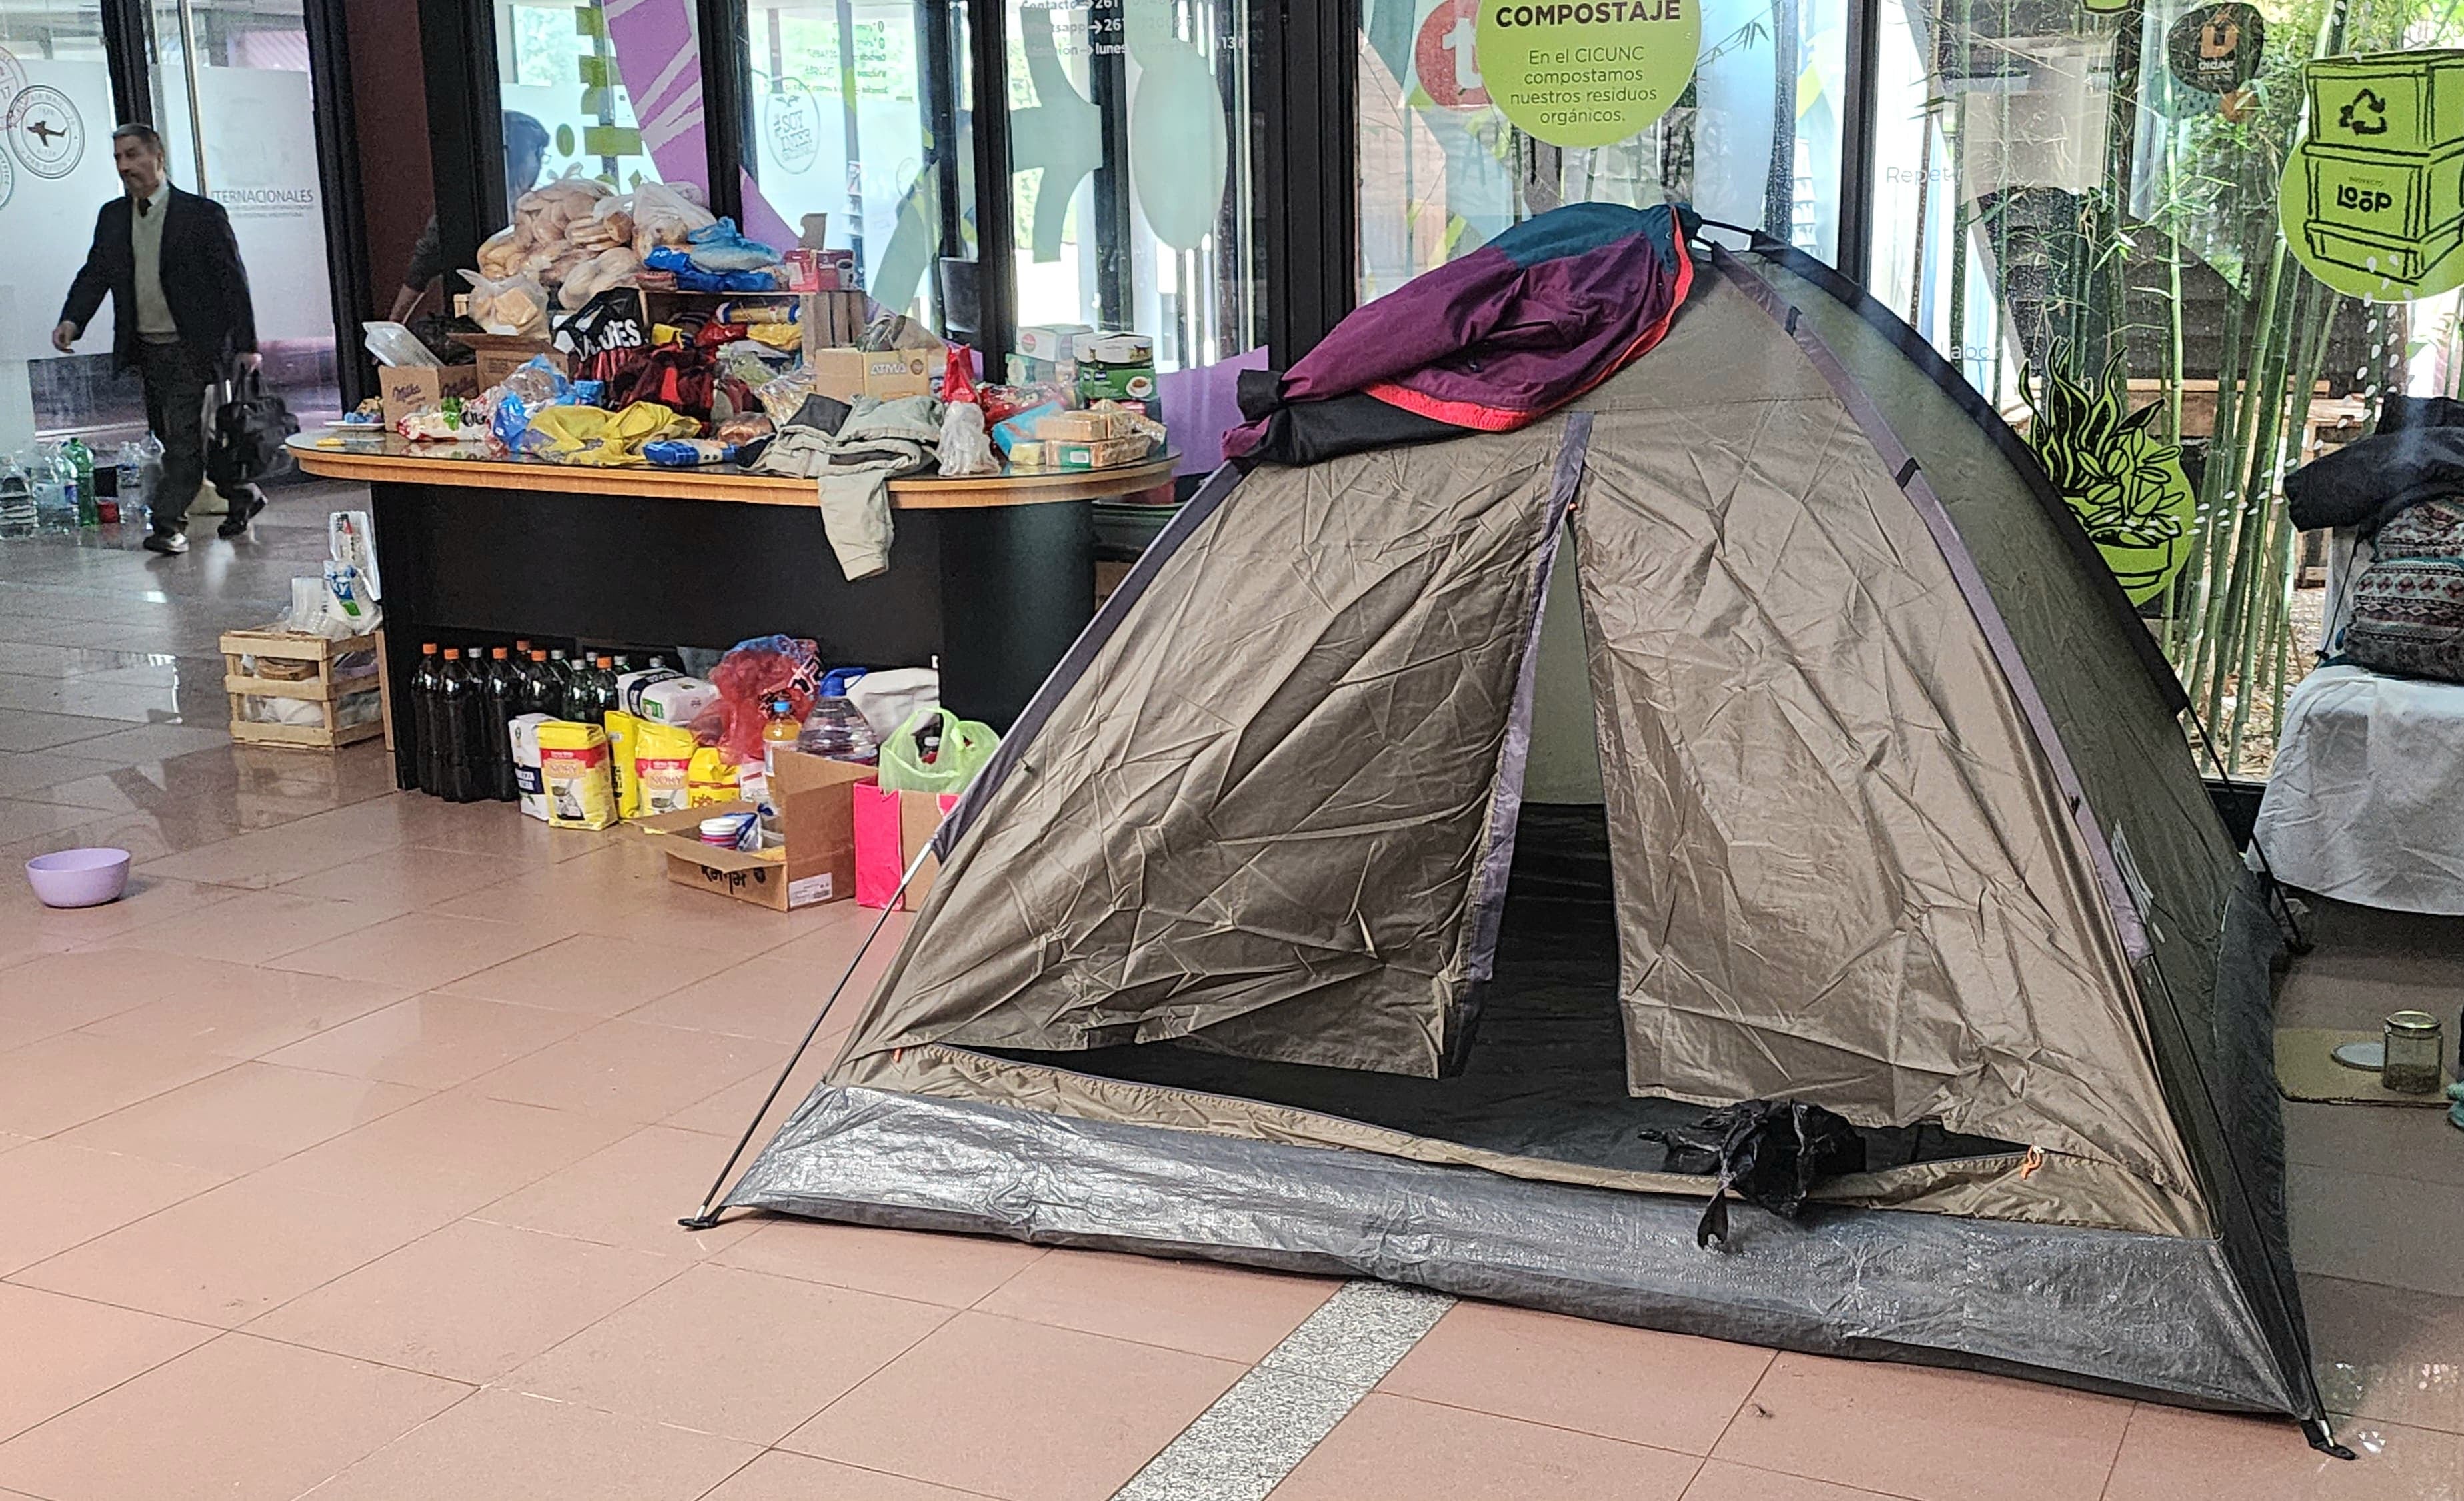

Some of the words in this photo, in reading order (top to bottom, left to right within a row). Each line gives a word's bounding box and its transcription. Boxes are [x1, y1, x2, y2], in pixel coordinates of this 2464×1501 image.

[1496, 0, 1681, 27] COMPOSTAJE
[1529, 50, 1550, 65] En
[1556, 49, 1569, 63] el
[1575, 46, 1644, 63] CICUNC
[1524, 69, 1643, 85] compostamos
[1510, 91, 1580, 105] nuestros
[1586, 87, 1657, 103] residuos
[1540, 108, 1625, 125] orgánicos.
[870, 363, 906, 375] ATMA
